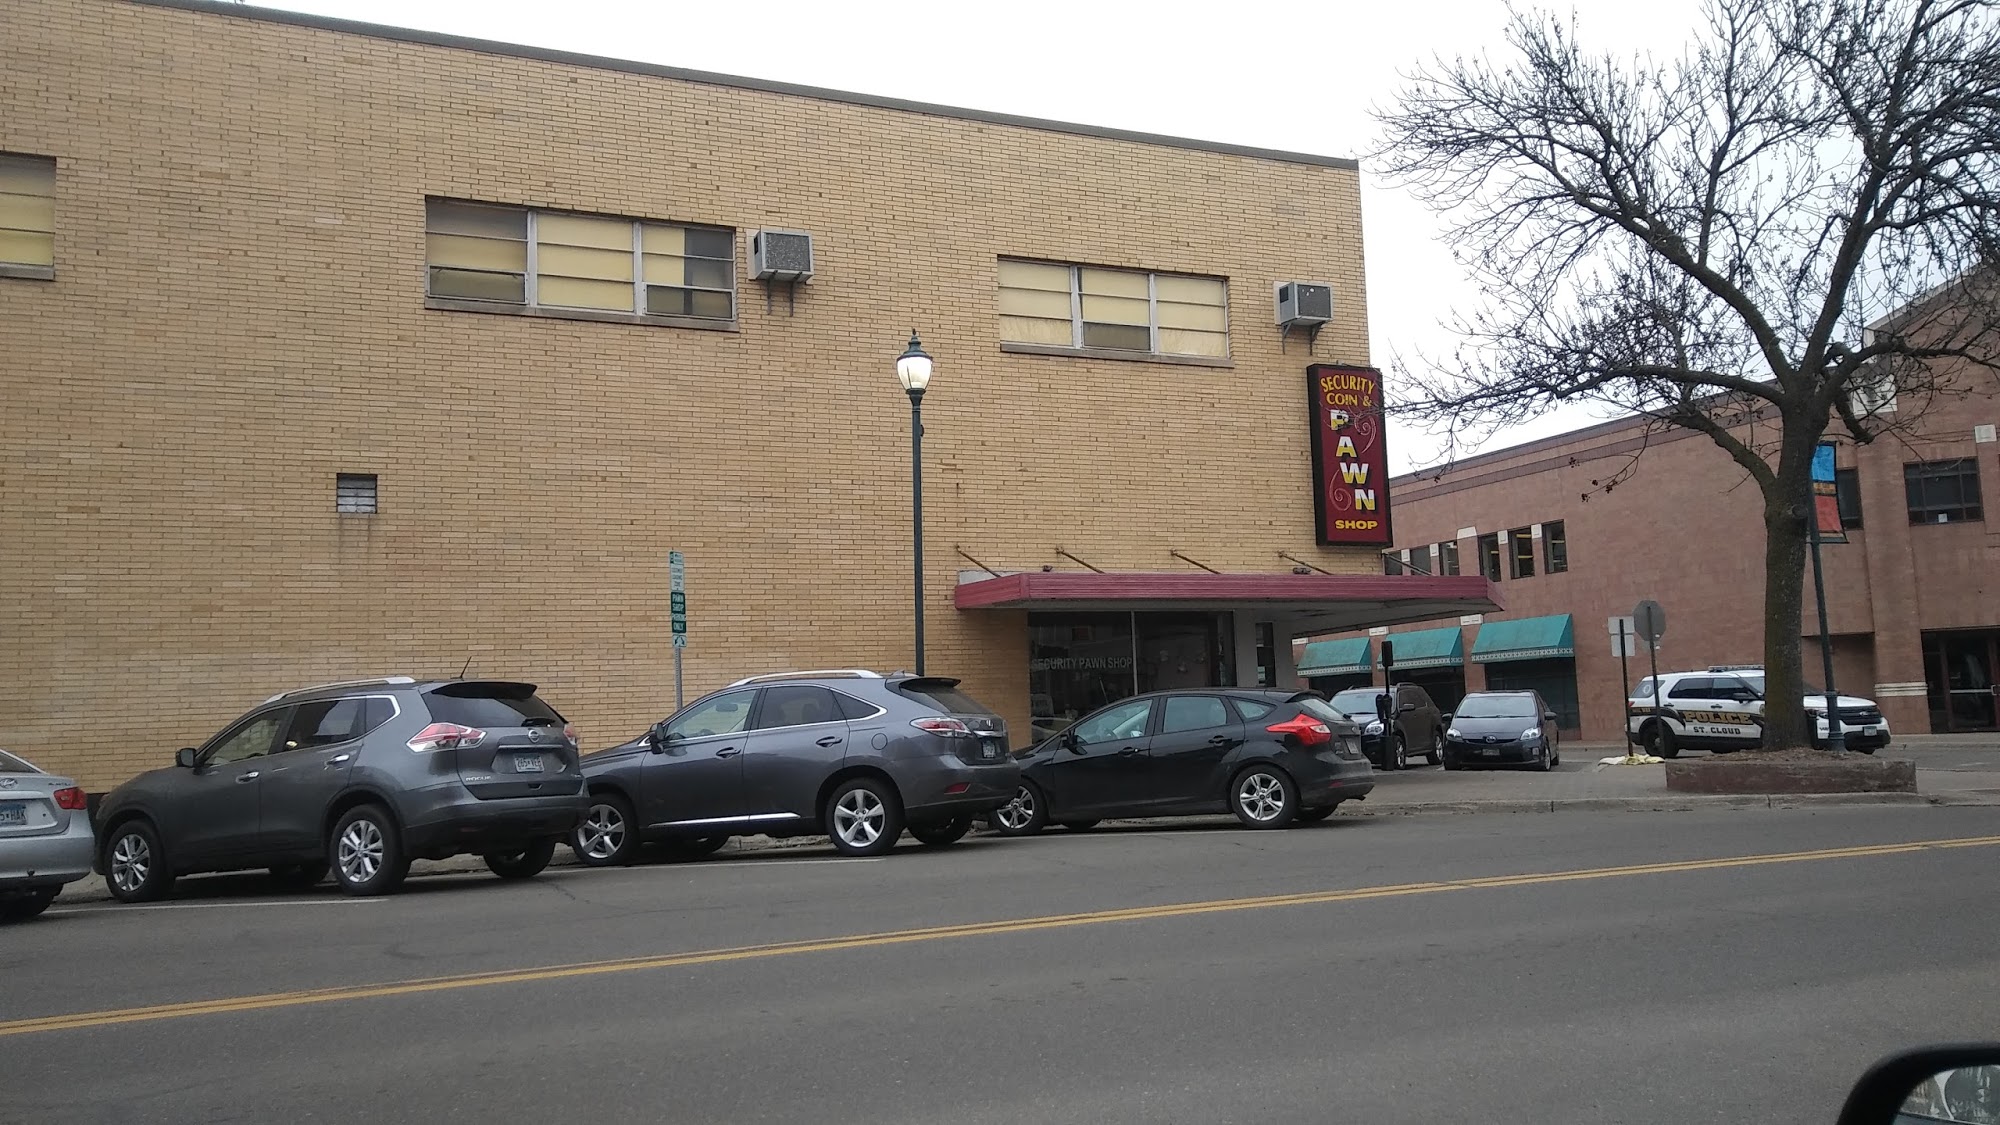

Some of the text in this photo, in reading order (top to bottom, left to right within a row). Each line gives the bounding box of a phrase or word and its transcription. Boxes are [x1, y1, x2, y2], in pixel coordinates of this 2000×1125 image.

[1320, 374, 1376, 395] SECURITY
[1326, 392, 1372, 407] COIN &
[1330, 409, 1376, 511] PAWN
[1334, 519, 1378, 530] SHOP
[1032, 656, 1132, 670] SECURITY PAWN SHOP
[1682, 711, 1754, 725] POLICE
[1693, 726, 1741, 735] ST. CLOUD
